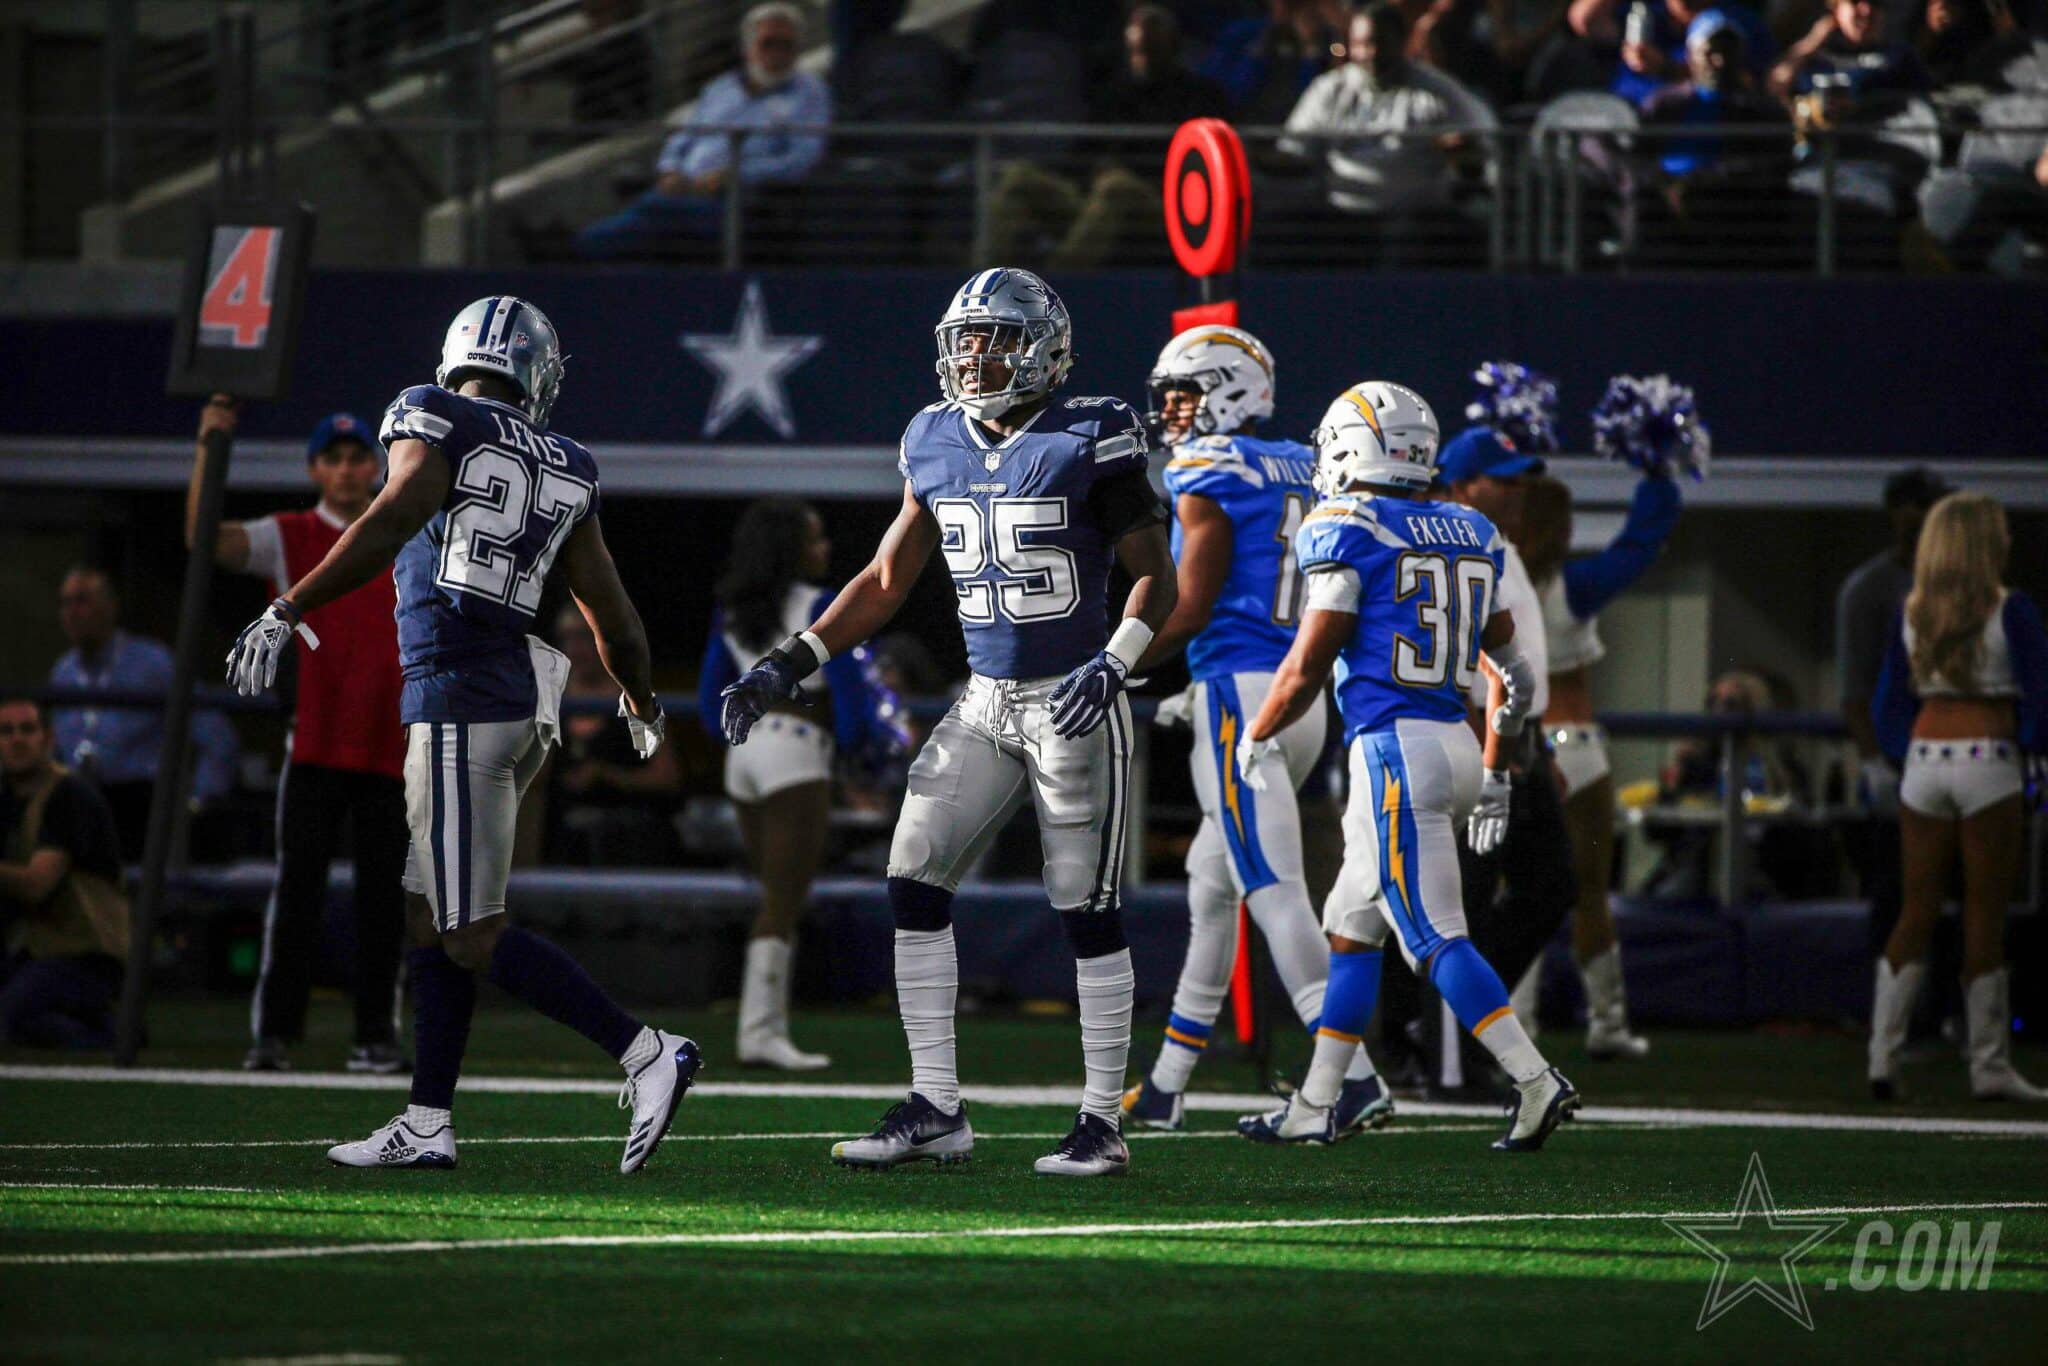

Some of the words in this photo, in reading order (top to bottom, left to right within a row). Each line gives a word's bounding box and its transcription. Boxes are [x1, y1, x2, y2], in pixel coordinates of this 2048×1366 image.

[201, 225, 272, 346] 4
[491, 412, 568, 467] LEWIS
[436, 443, 594, 617] 27
[932, 496, 1080, 624] 25
[1406, 516, 1481, 547] EKELER
[1392, 550, 1496, 692] 30
